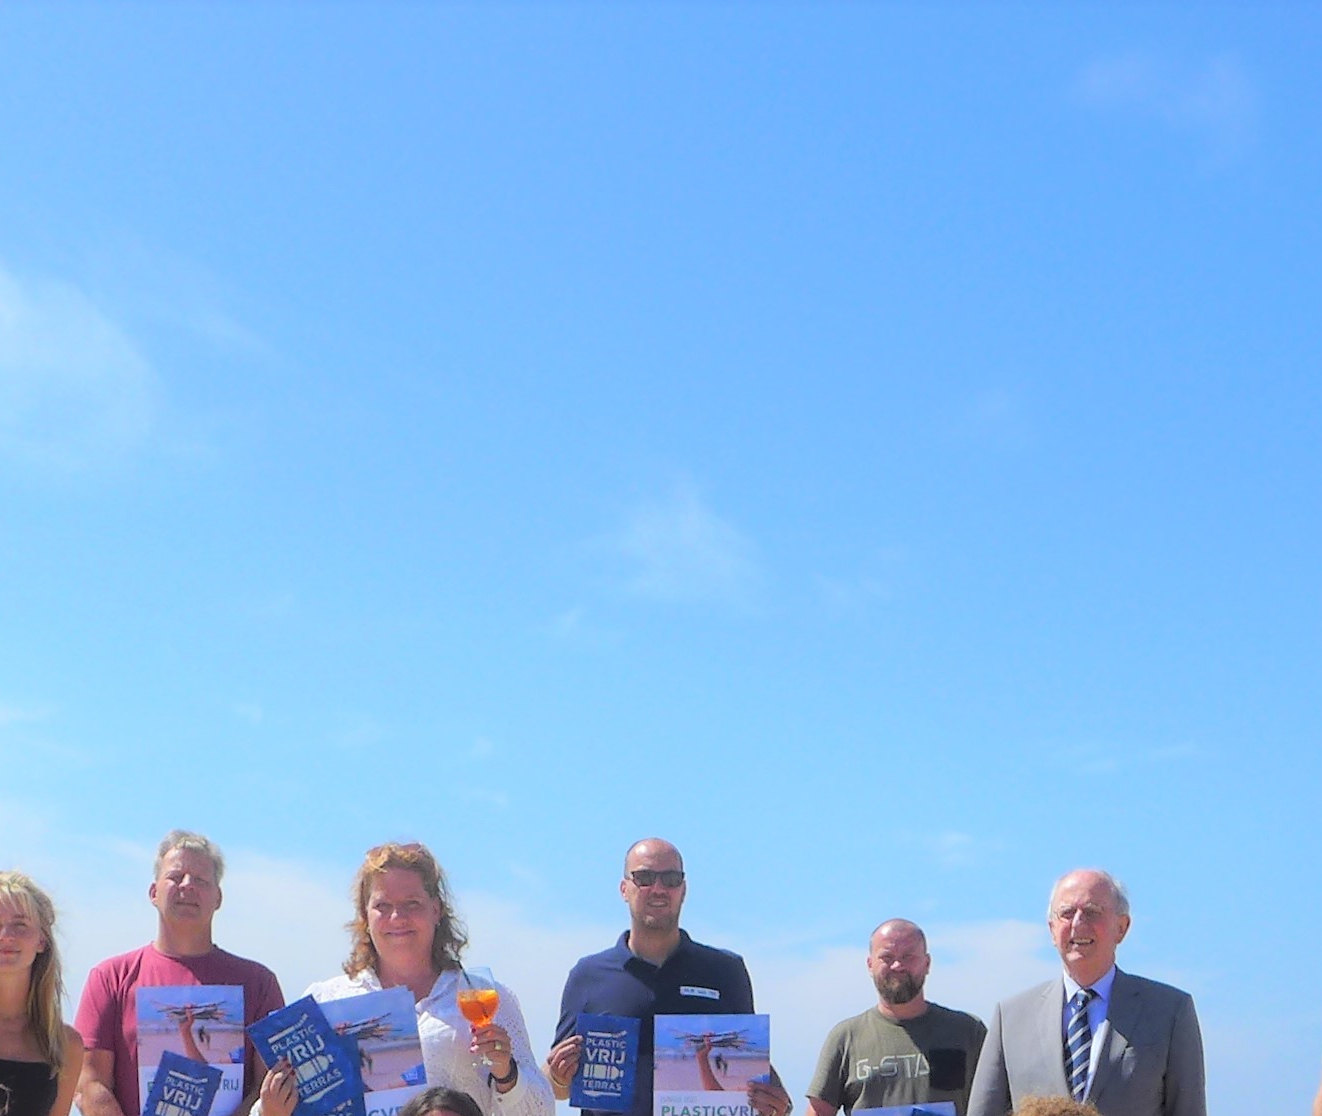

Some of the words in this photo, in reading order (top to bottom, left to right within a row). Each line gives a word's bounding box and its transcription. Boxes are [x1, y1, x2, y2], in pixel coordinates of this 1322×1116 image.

[271, 1024, 317, 1055] PLASTIC
[585, 1037, 627, 1049] PLASTIC
[586, 1049, 626, 1064] VRIJ
[165, 1076, 206, 1097] PLASTIC
[298, 1068, 343, 1097] TERRAS
[583, 1079, 622, 1091] TERRAS
[163, 1085, 203, 1111] VRIJ
